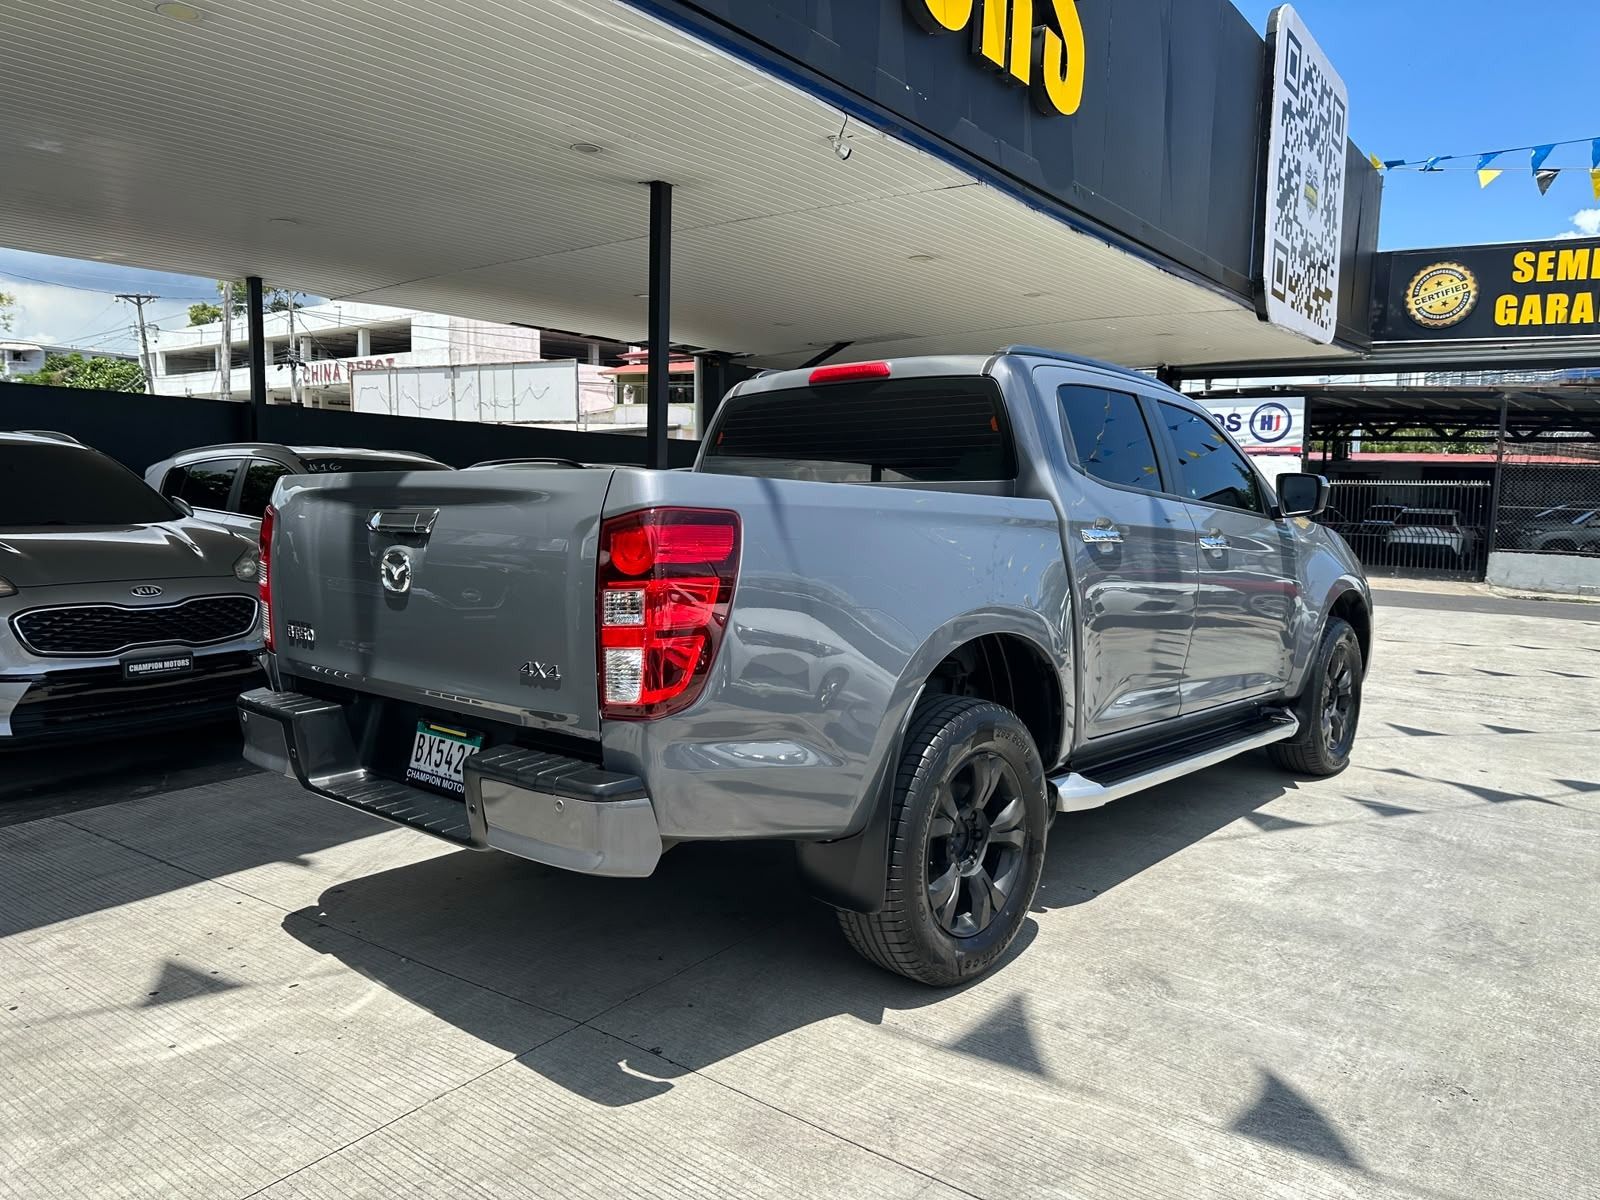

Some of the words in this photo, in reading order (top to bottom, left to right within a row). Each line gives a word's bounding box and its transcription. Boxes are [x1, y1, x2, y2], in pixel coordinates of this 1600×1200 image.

[1414, 282, 1469, 306] CERTIFIED
[1494, 292, 1600, 326] GARA
[303, 363, 342, 384] CHINA
[1259, 414, 1281, 432] HJ
[136, 587, 159, 595] KIA
[128, 662, 163, 672] CHAMPION
[163, 658, 190, 668] MOTORS
[414, 733, 475, 775] BX542
[406, 768, 442, 787] CHAMPION
